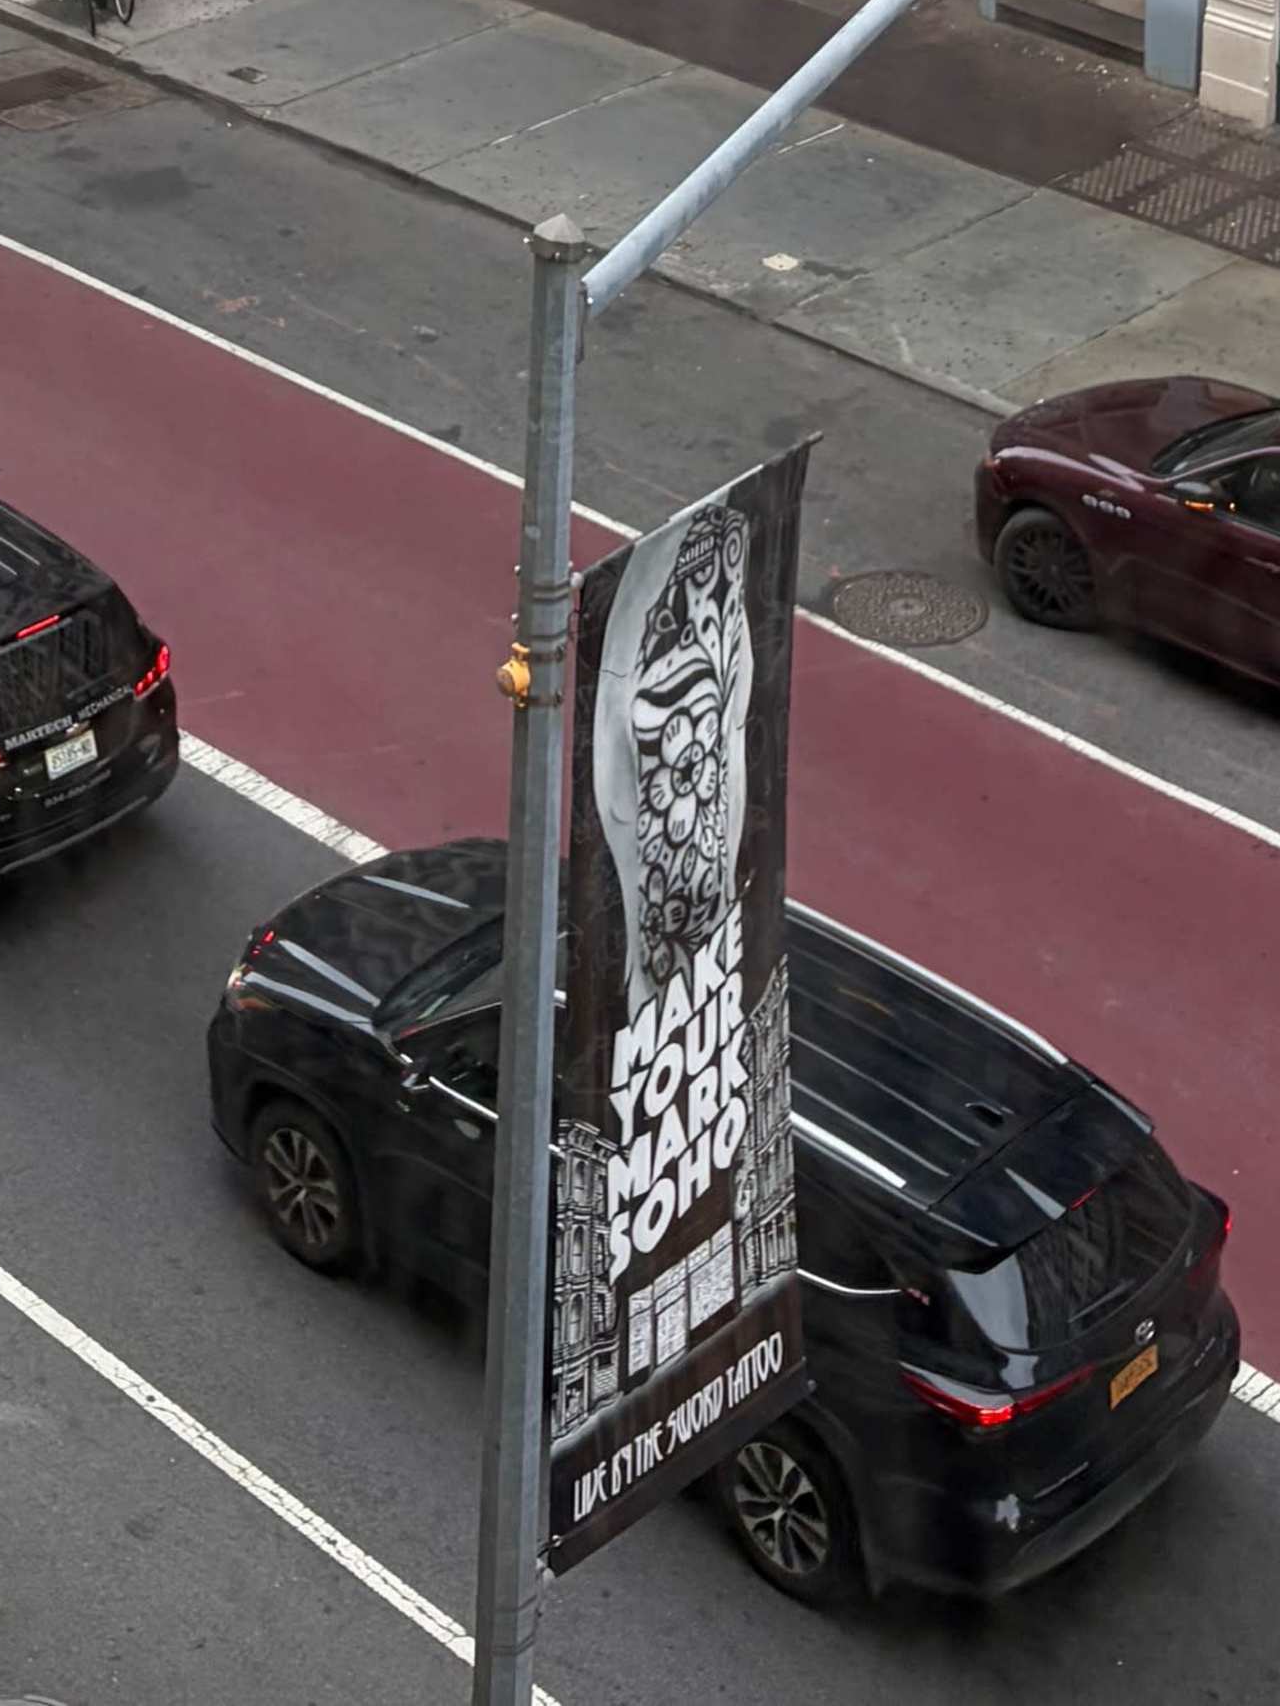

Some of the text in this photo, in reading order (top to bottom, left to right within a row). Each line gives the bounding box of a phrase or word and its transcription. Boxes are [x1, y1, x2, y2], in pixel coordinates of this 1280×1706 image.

[5, 715, 73, 751] MARTECH
[609, 971, 744, 1147] YOUR
[611, 900, 743, 1088] MAKE
[608, 1022, 749, 1222] MARK
[609, 1097, 748, 1286] SOHO
[574, 1332, 783, 1522] LIVE BY THE SWORD TATTOO
